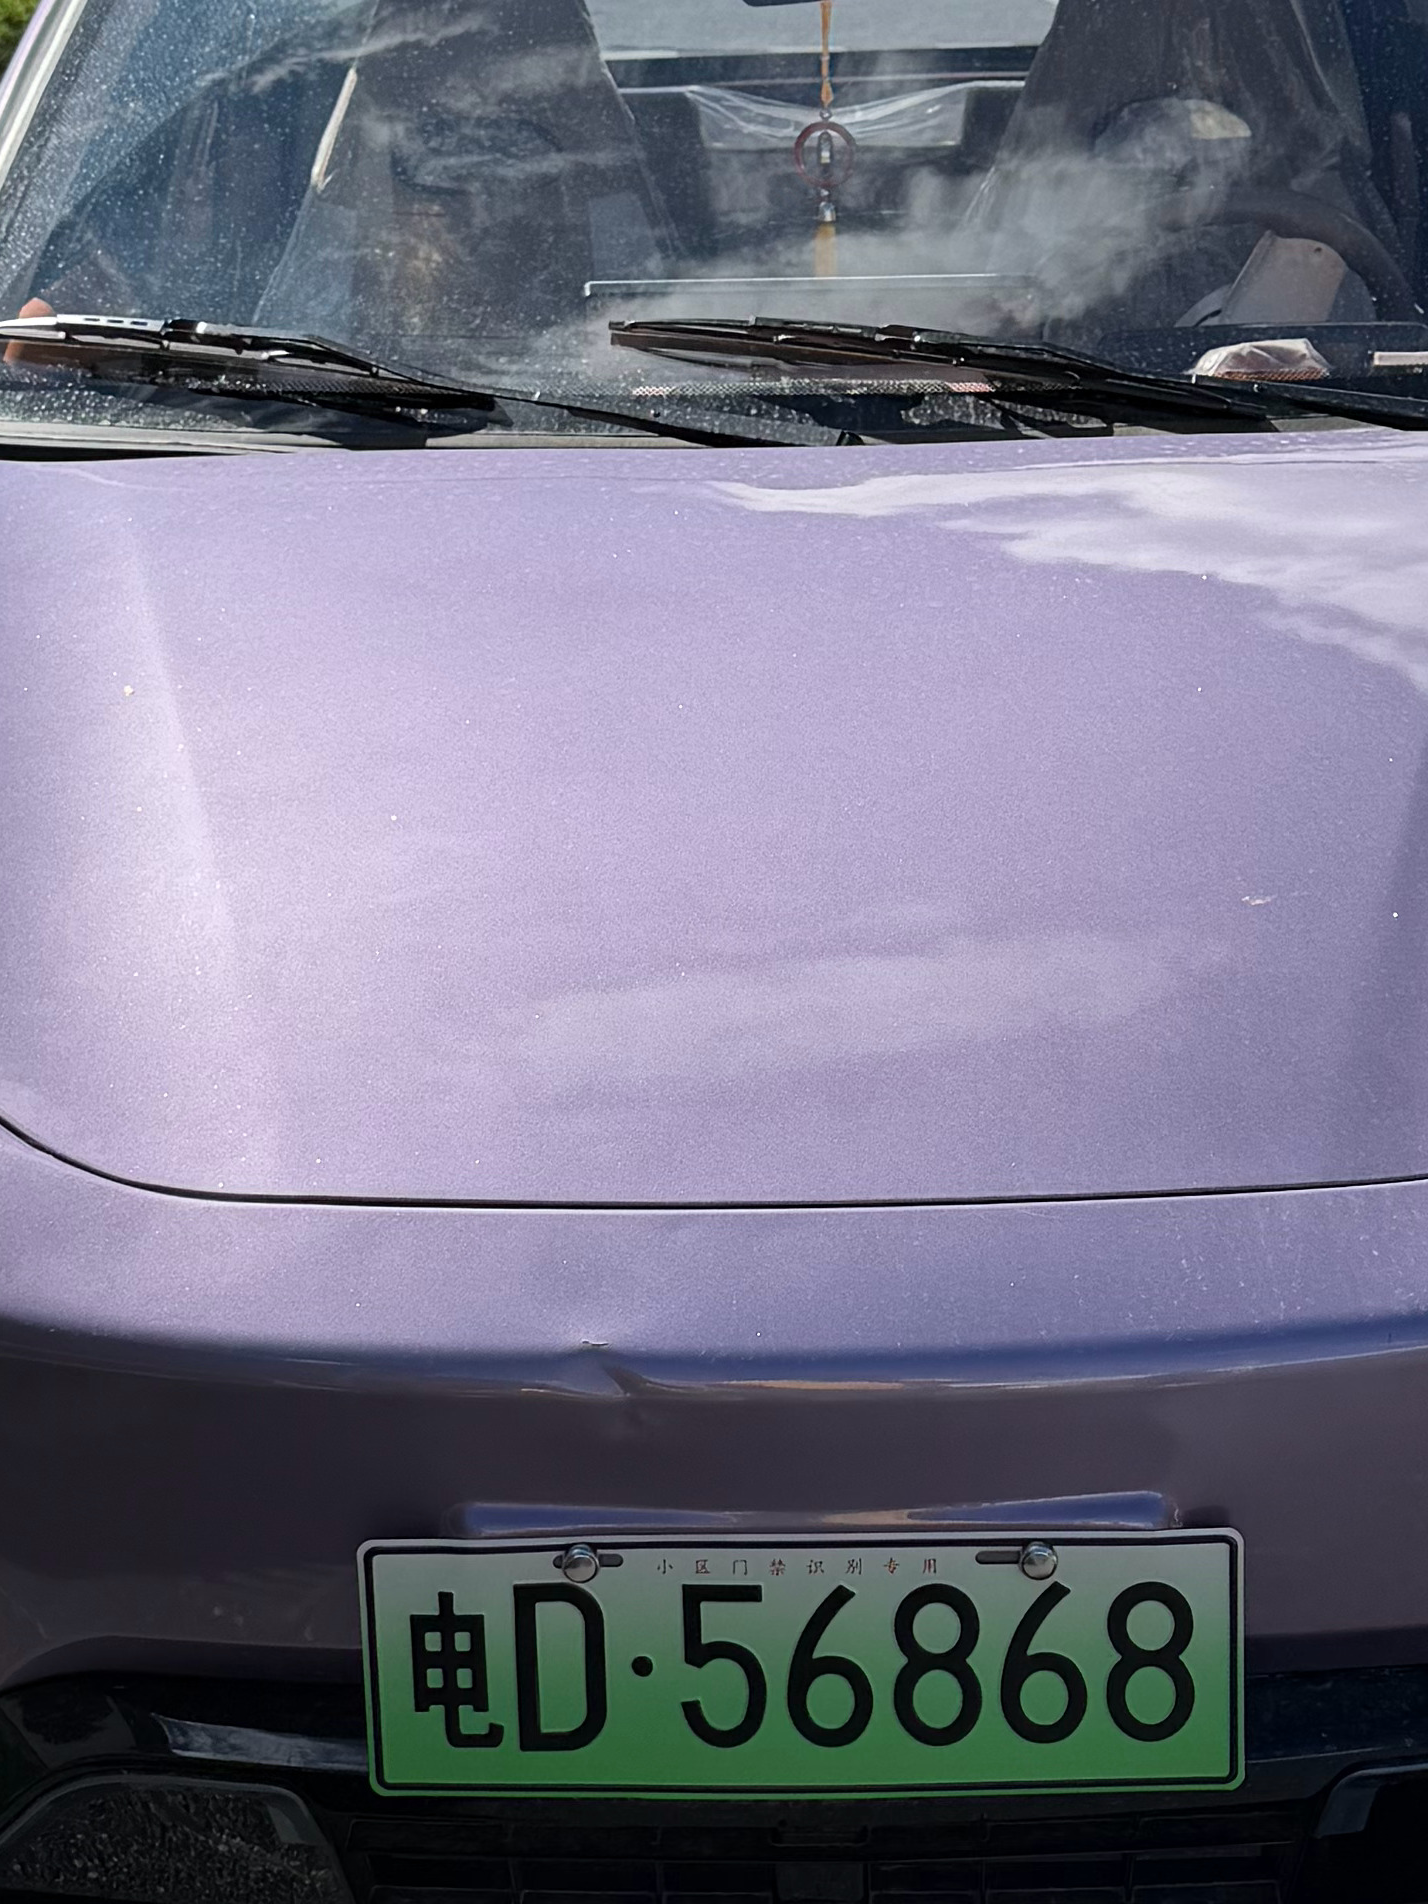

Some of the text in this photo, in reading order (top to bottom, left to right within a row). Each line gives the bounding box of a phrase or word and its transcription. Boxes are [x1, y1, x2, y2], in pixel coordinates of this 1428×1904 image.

[656, 1557, 939, 1577] 小区门禁识别专用
